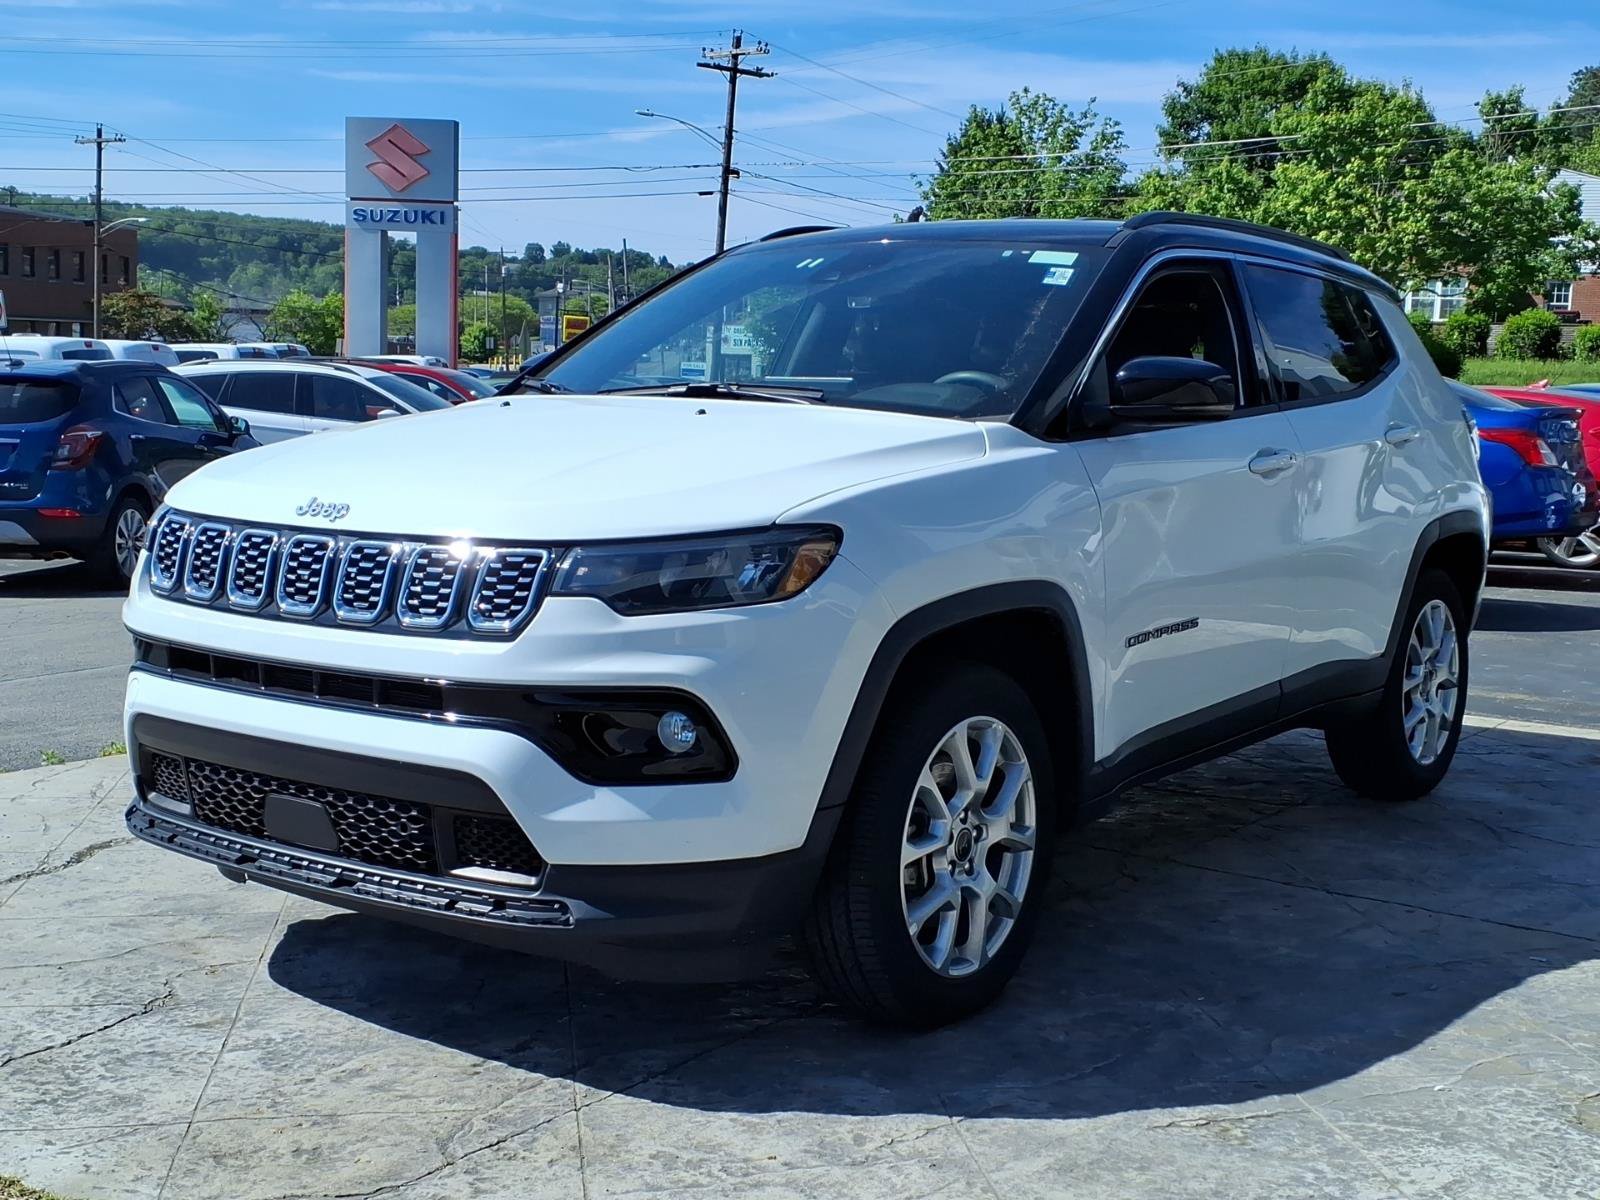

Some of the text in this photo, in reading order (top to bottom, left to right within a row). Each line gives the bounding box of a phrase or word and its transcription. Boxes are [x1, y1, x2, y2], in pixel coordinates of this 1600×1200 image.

[352, 207, 445, 225] SUZUKI
[296, 496, 351, 523] Jeep
[1125, 616, 1200, 648] COMPASS
